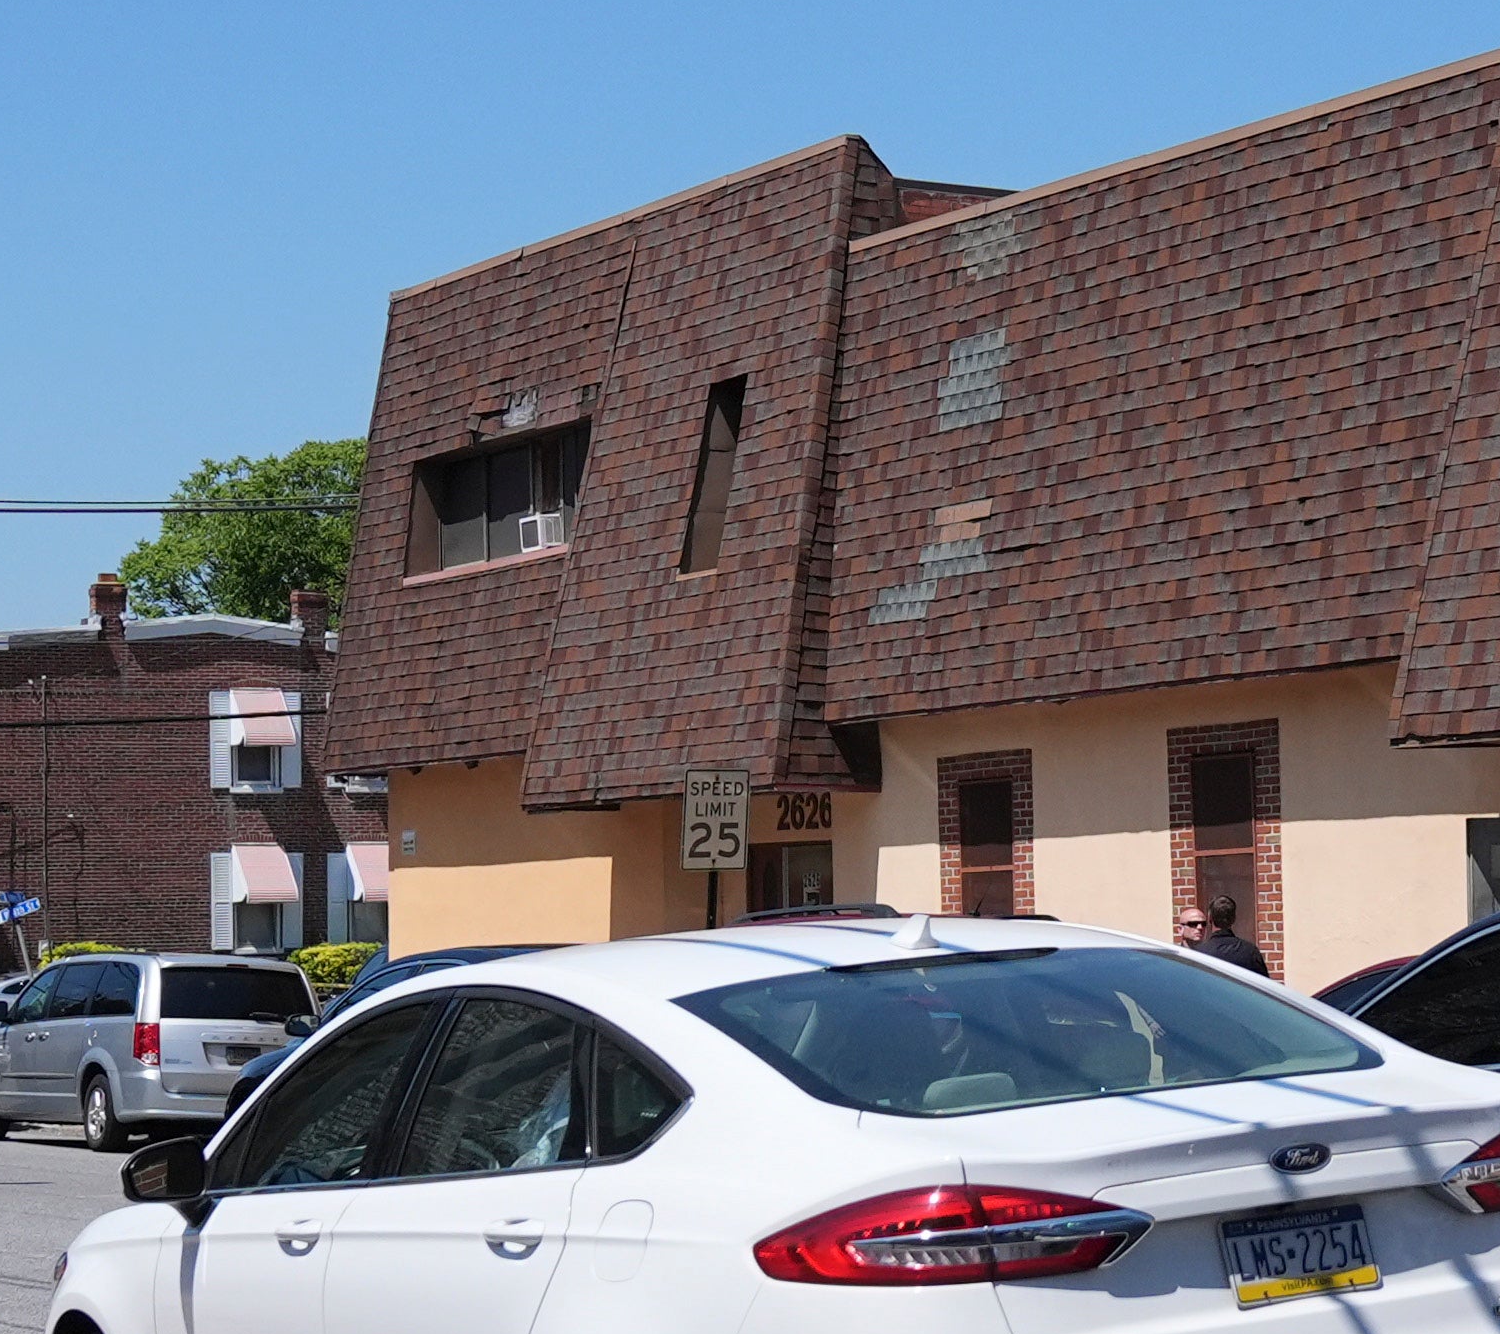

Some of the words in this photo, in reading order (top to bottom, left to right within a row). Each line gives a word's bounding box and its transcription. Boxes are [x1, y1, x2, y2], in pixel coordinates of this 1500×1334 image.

[690, 782, 744, 796] SPEED
[695, 802, 737, 817] LIMIT
[776, 792, 832, 831] 2626
[688, 822, 740, 858] 25
[1284, 1147, 1320, 1167] Ford
[1257, 1213, 1330, 1231] PENNSYLVANIA
